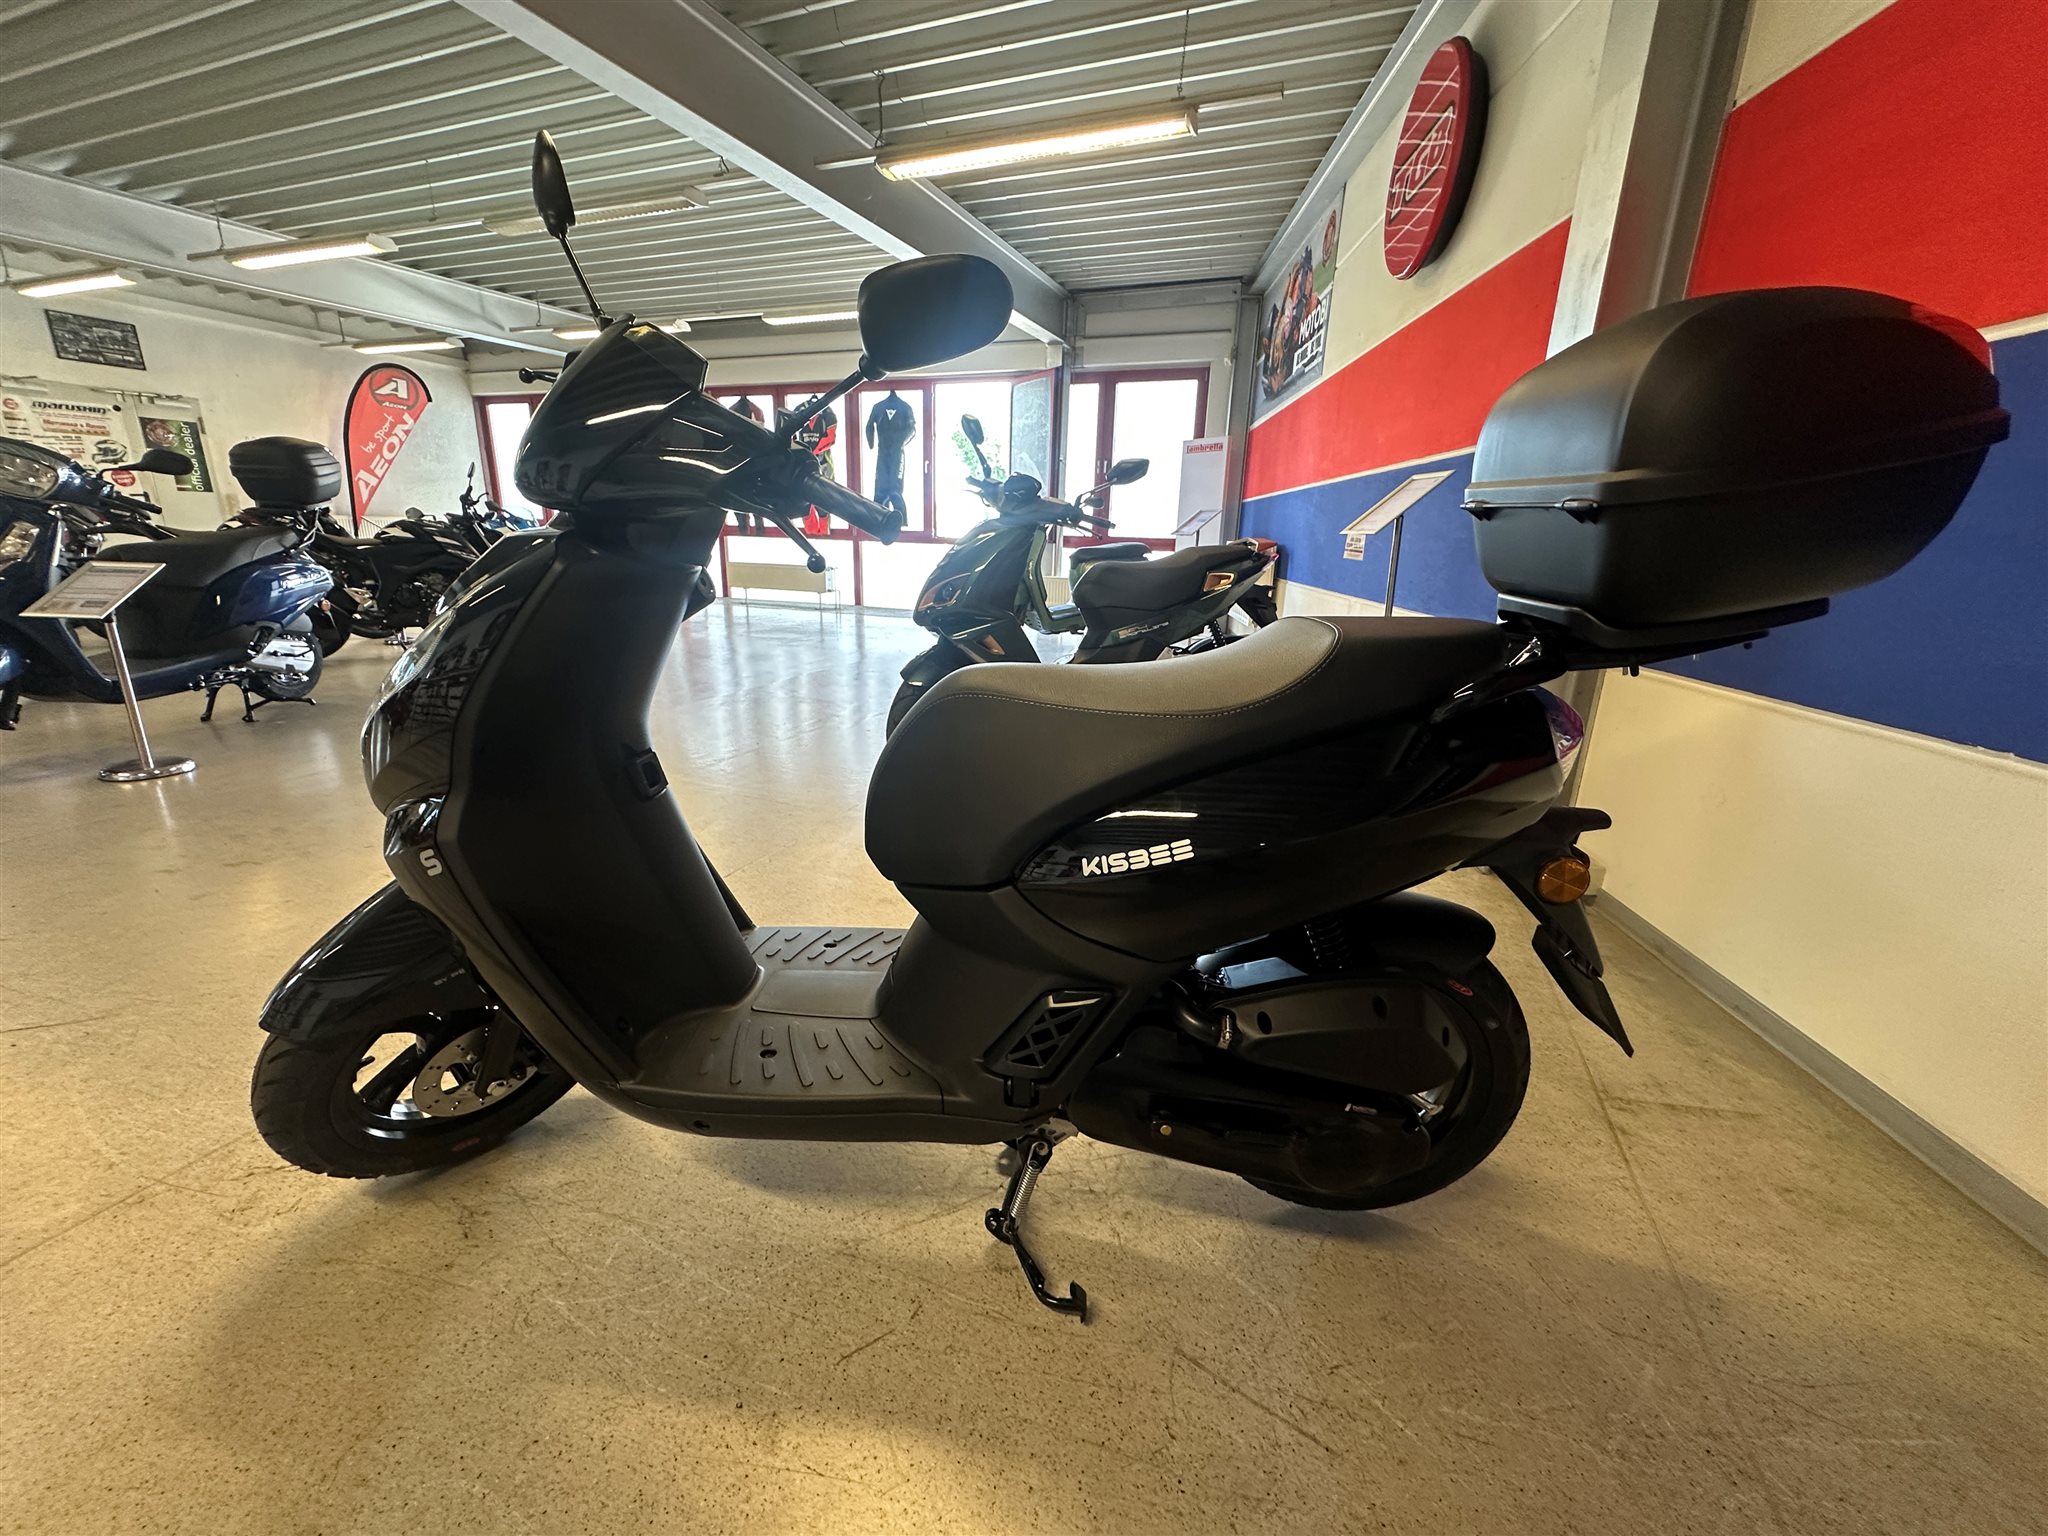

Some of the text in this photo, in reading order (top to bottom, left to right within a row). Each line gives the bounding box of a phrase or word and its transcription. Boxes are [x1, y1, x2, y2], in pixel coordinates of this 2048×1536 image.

[180, 422, 195, 455] dealer
[361, 413, 395, 454] be sport
[355, 412, 415, 504] AEON
[419, 848, 442, 877] S
[1082, 838, 1195, 877] KISBEE
